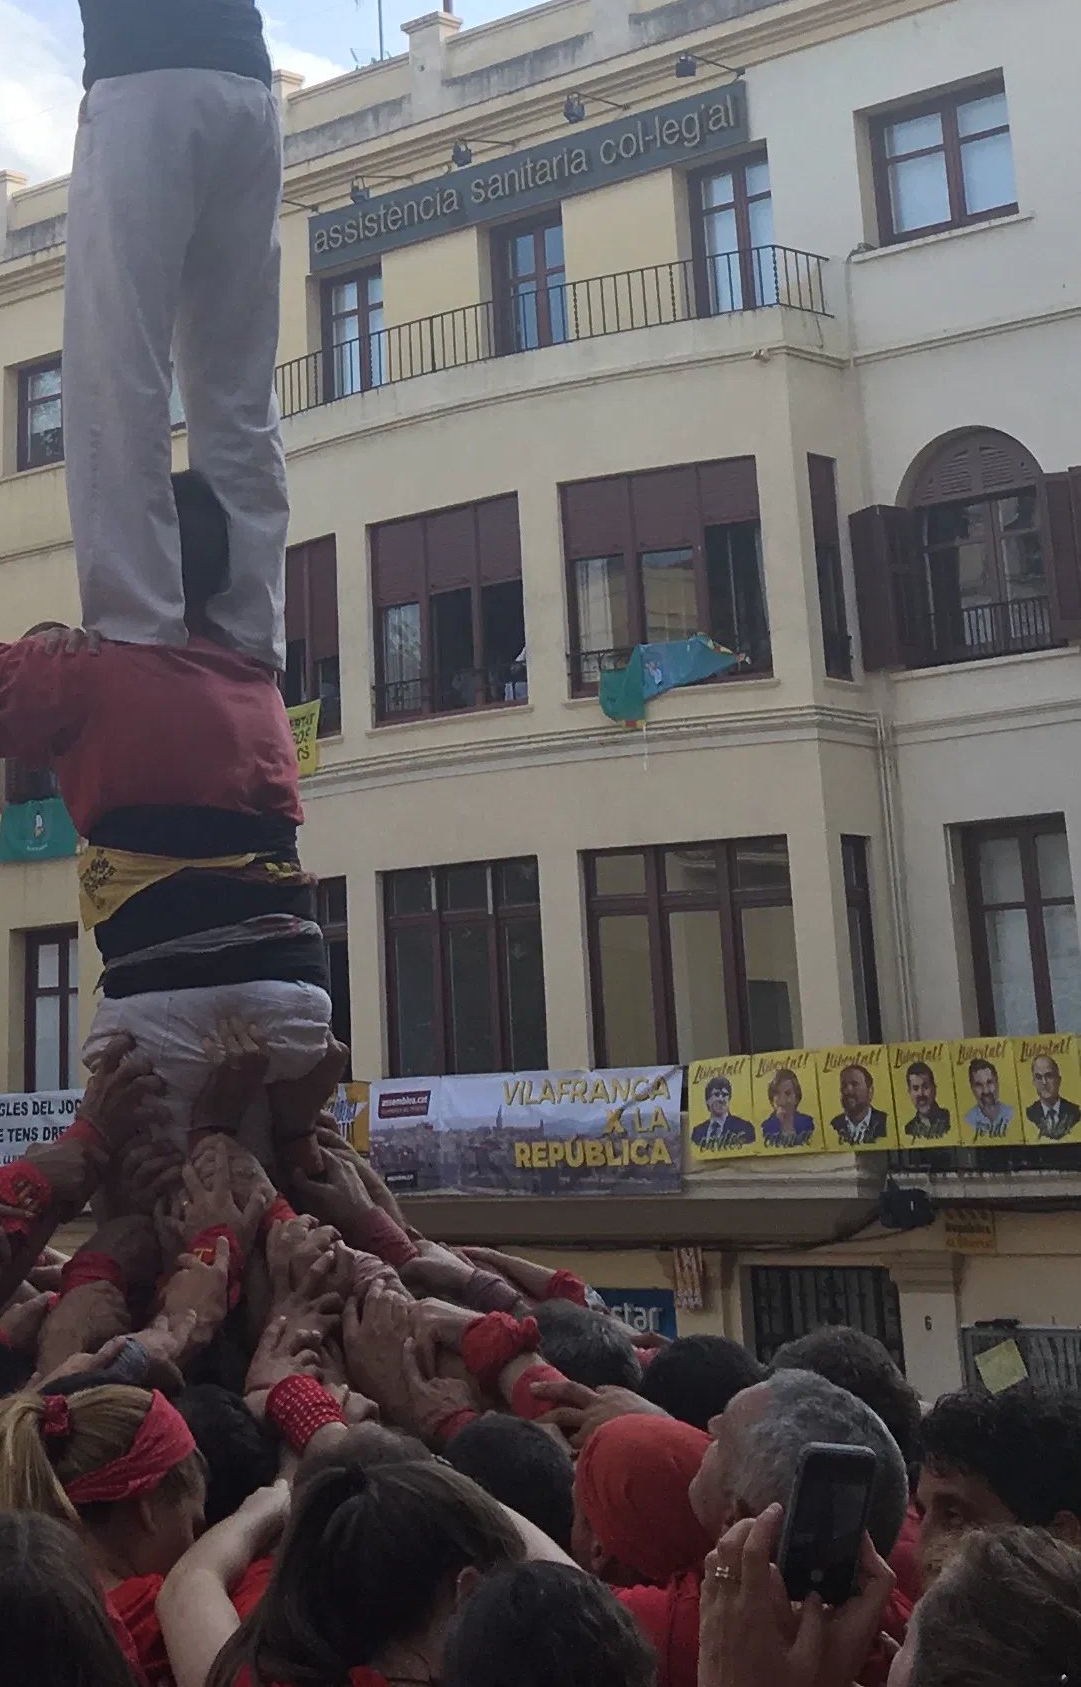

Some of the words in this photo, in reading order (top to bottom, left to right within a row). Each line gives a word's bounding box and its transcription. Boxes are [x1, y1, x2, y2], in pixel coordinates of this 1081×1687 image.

[313, 187, 460, 254] assistència
[470, 146, 589, 204] sanitaria
[503, 1076, 671, 1106] VILAFRANCA
[31, 1100, 55, 1116] DEL
[604, 1109, 626, 1135] X
[633, 1105, 670, 1133] LA
[7, 1126, 38, 1143] TENS
[514, 1132, 673, 1168] REPÚBLICA
[924, 1315, 932, 1332] 6
